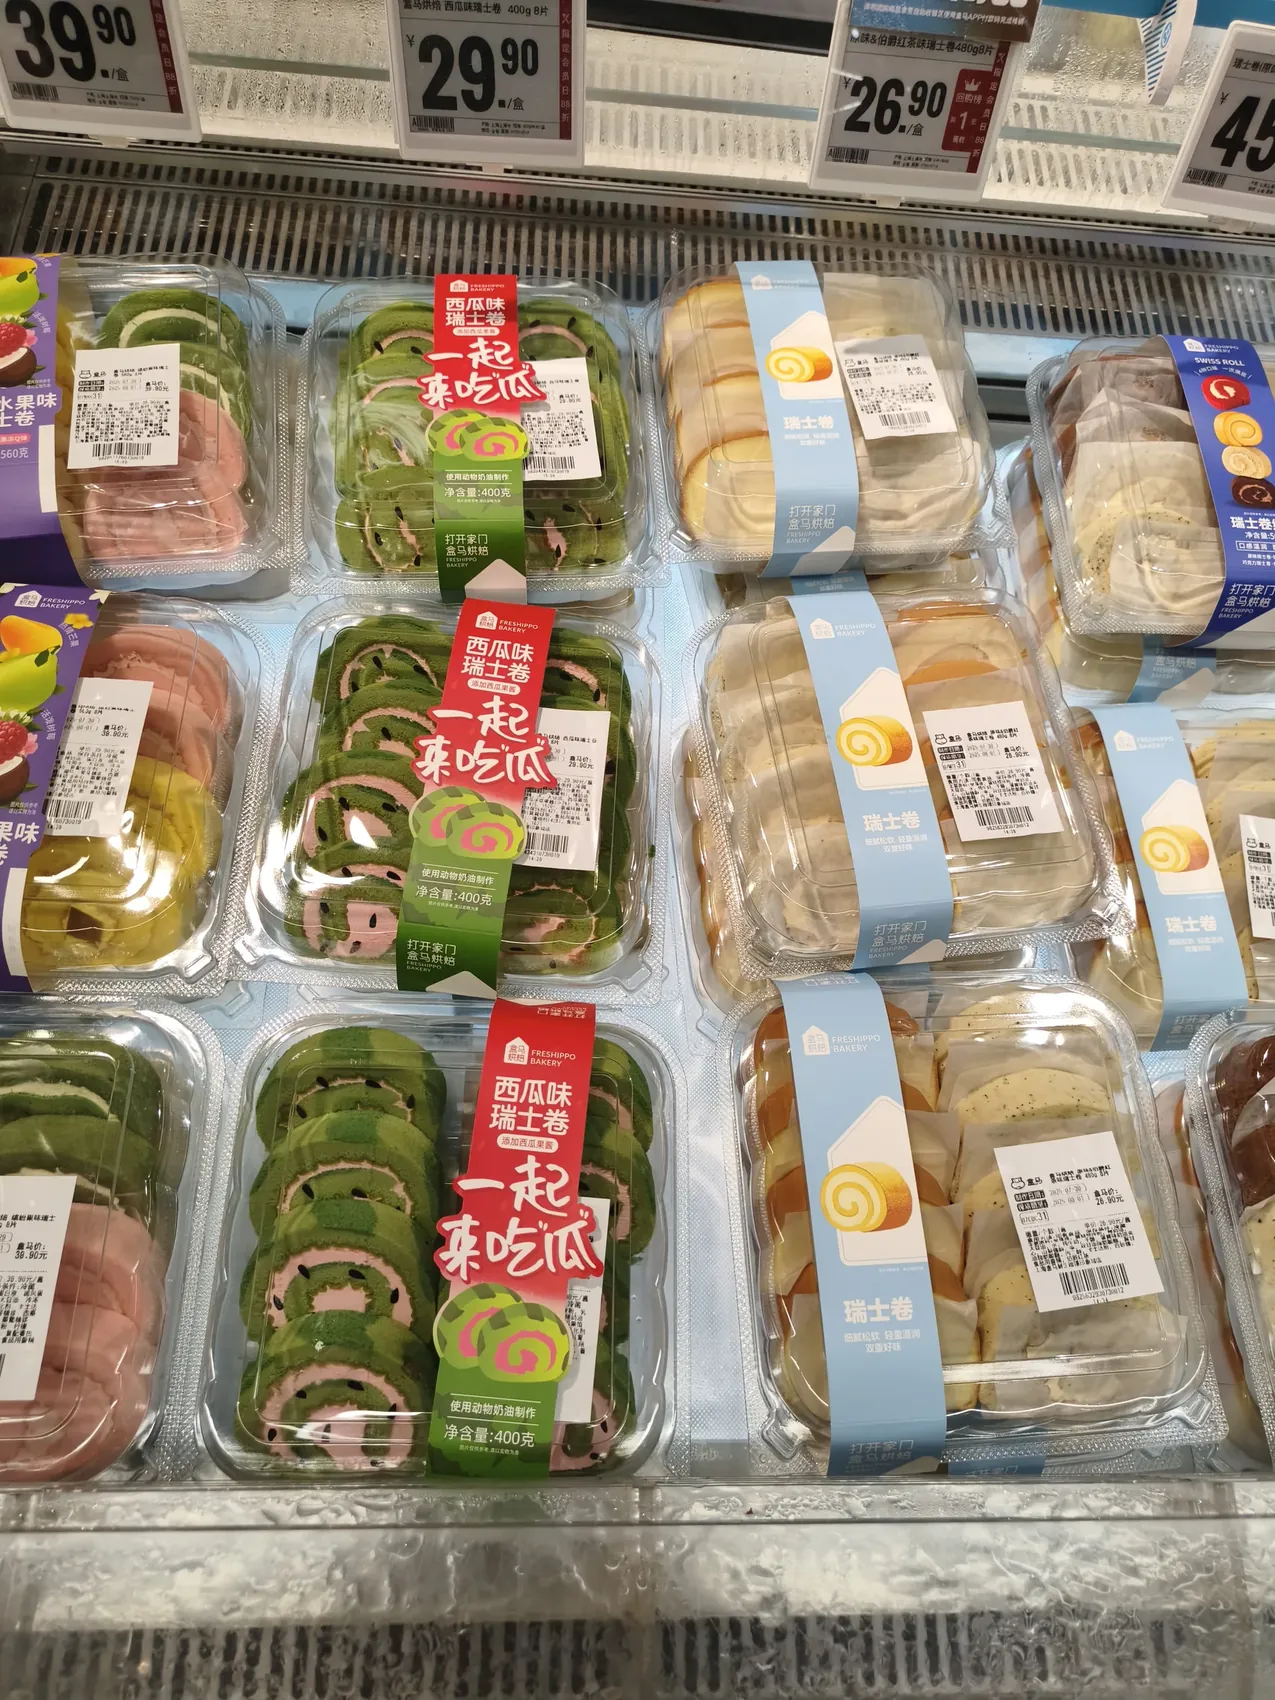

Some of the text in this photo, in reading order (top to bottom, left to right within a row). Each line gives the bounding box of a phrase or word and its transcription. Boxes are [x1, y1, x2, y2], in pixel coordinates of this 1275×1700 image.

[444, 0, 501, 14] 西瓜味瑞士卷
[508, 4, 531, 17] 400g
[533, 5, 548, 16] 8片
[445, 297, 506, 311] 西瓜味
[445, 311, 506, 326] 瑞士卷
[427, 337, 514, 370] 一起
[1194, 357, 1245, 367] SWISS ROLL
[420, 363, 541, 409] 来吃瓜
[783, 415, 834, 430] 瑞士卷
[0, 447, 28, 460] 560克
[446, 473, 509, 481] 使用动物奶油制作
[444, 487, 511, 498] 净含量:400克
[789, 505, 836, 517] 打开家门
[788, 518, 835, 531] 盒马烘焙
[445, 534, 488, 545] 打开家门
[1245, 531, 1275, 540] 净含量:5
[446, 546, 488, 556] 盒马烘焙
[1230, 583, 1275, 596] 打开家门
[42, 597, 86, 605] FRESHIPPO
[1225, 596, 1271, 608] 盒马烘焙
[500, 620, 539, 630] FRESHIPPO
[834, 623, 876, 631] FRESHIPPO
[466, 636, 535, 663] 西瓜味
[461, 655, 531, 684] 瑞士卷
[471, 680, 516, 693] 添加西瓜果酱
[432, 695, 529, 743] 一起
[416, 735, 551, 784] 来吃瓜
[863, 810, 920, 832] 瑞士卷
[422, 867, 494, 886] 使用动物奶油制作
[416, 886, 493, 907] 净含量:400克
[874, 920, 927, 936] 打开家门
[1165, 914, 1217, 933] 瑞士卷
[407, 939, 457, 955] 打开家门
[872, 932, 925, 947] 盒马烘焙
[406, 951, 456, 967] 盒马烘焙
[406, 961, 442, 969] FRESHIPPO
[406, 965, 432, 973] BAKERY
[831, 1034, 880, 1044] FRESHIPPO
[531, 1049, 576, 1060] FRESHIPPO
[833, 1044, 868, 1053] BAKERY
[530, 1058, 562, 1067] BAKERY
[493, 1075, 573, 1108] 西瓜味
[489, 1103, 570, 1136] 瑞士卷
[501, 1136, 554, 1150] 添加西瓜果酱
[457, 1155, 571, 1217] 一起
[439, 1209, 597, 1282] 来吃瓜
[15, 1250, 48, 1260] 39.90元
[843, 1296, 913, 1324] 瑞士卷
[450, 1400, 536, 1419] 使用动物奶油制作
[444, 1424, 535, 1448] 净含量:400克
[850, 1439, 914, 1454] 打开家门
